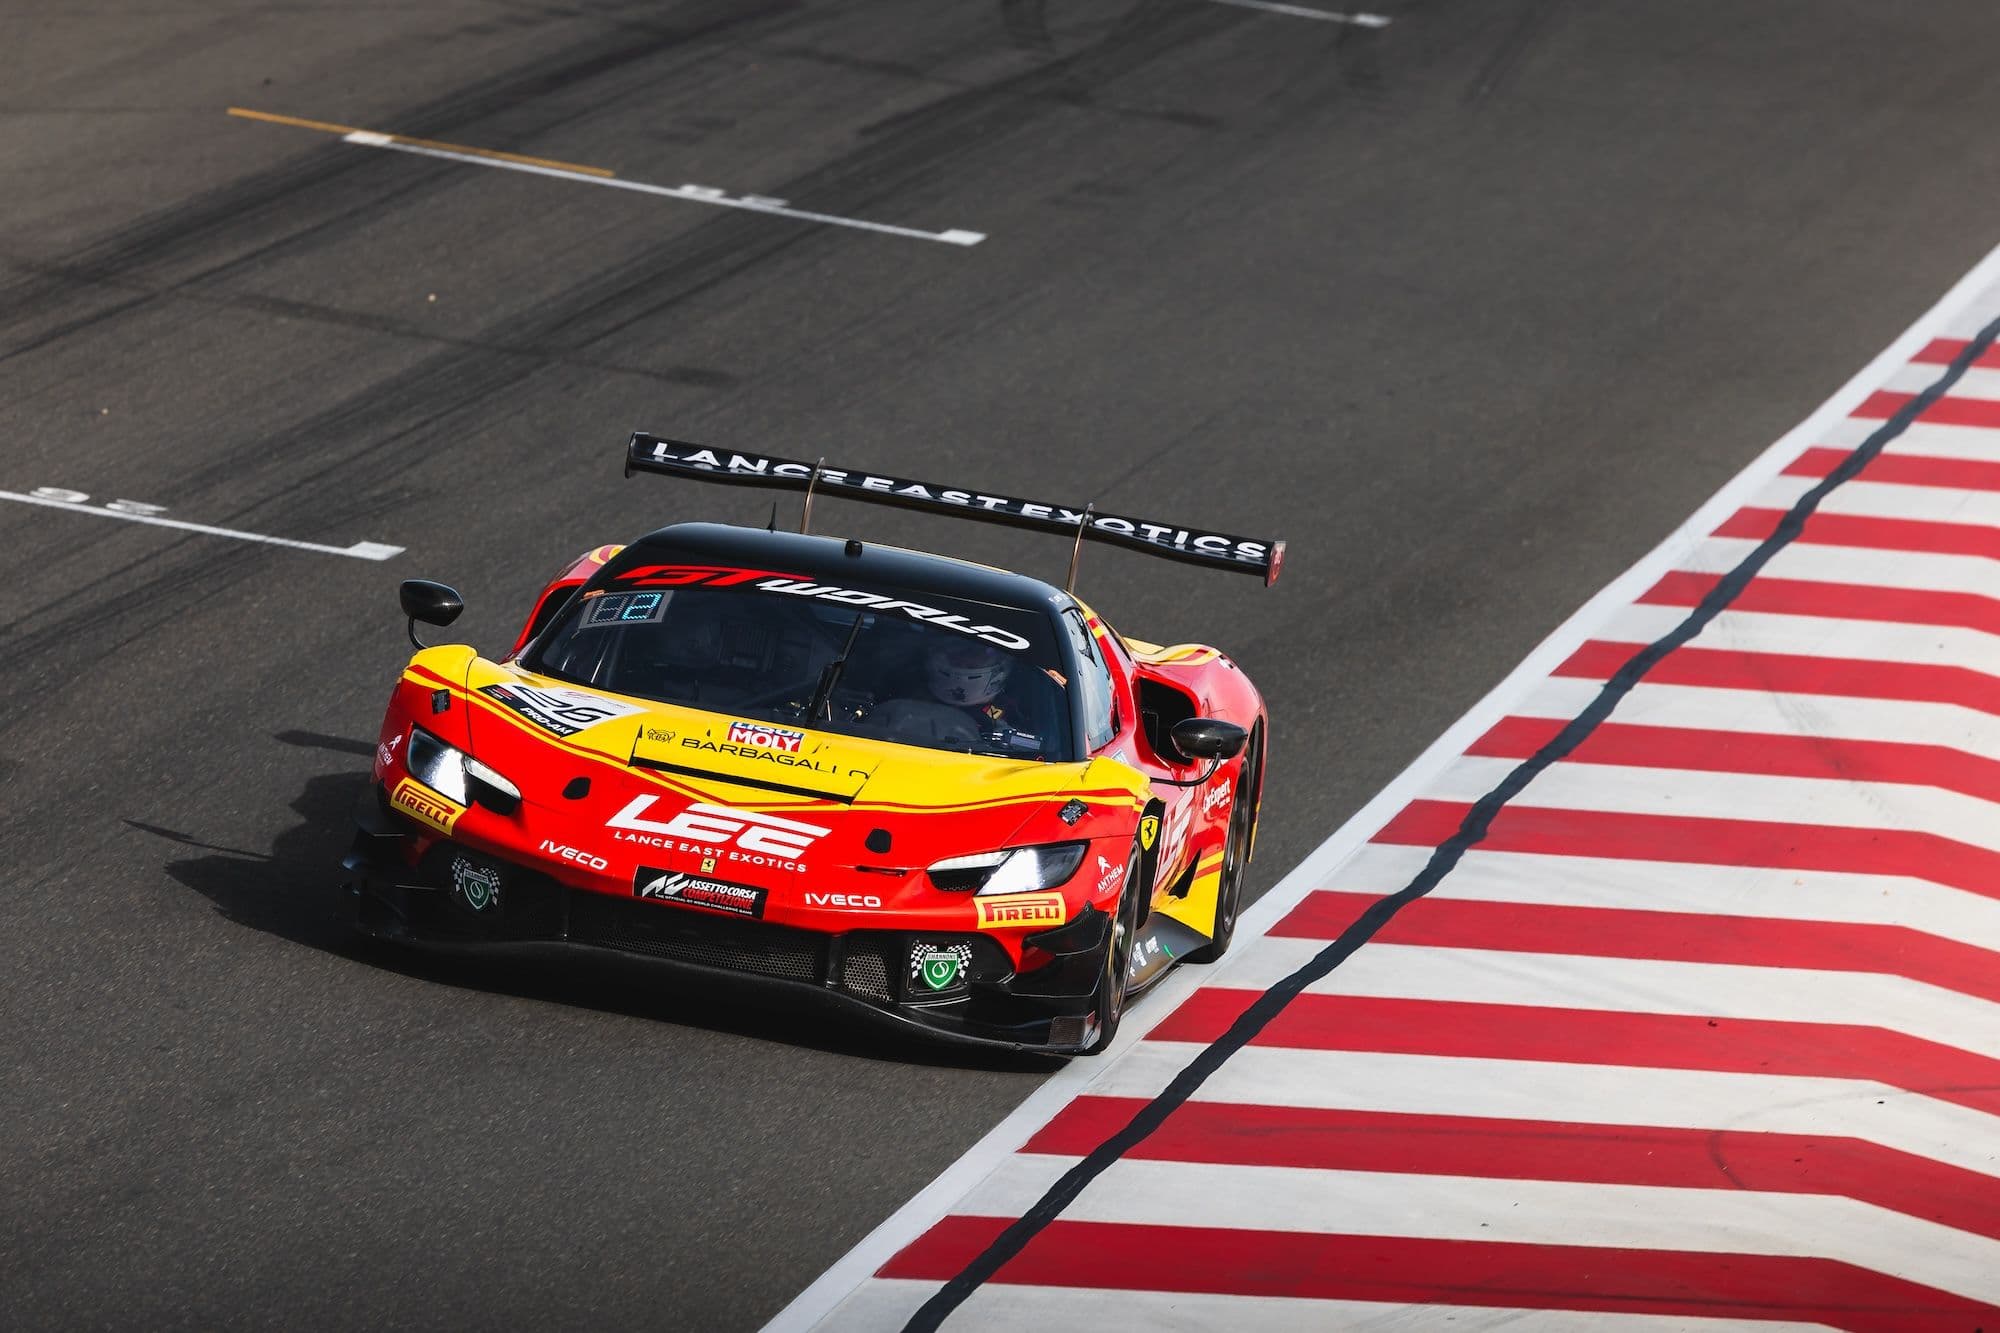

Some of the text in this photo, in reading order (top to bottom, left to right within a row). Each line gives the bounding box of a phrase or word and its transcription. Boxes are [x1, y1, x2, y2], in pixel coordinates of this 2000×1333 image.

[652, 442, 1267, 558] LANCE EAST EXOTICS
[615, 565, 1030, 650] GT WORLD
[519, 707, 574, 735] PRO-AM
[731, 728, 801, 752] MOLY
[395, 783, 456, 827] PIRELLI
[605, 794, 832, 859] LEE
[539, 839, 608, 871] IVECO
[614, 831, 807, 873] LANCE EAST EXOTICS
[688, 880, 757, 900] ASSETTO CORSA
[1098, 864, 1124, 892] ANTHEM
[681, 887, 754, 909] COMPETIZIONE
[804, 892, 882, 908] IVECO
[982, 899, 1060, 922] PIRELLI
